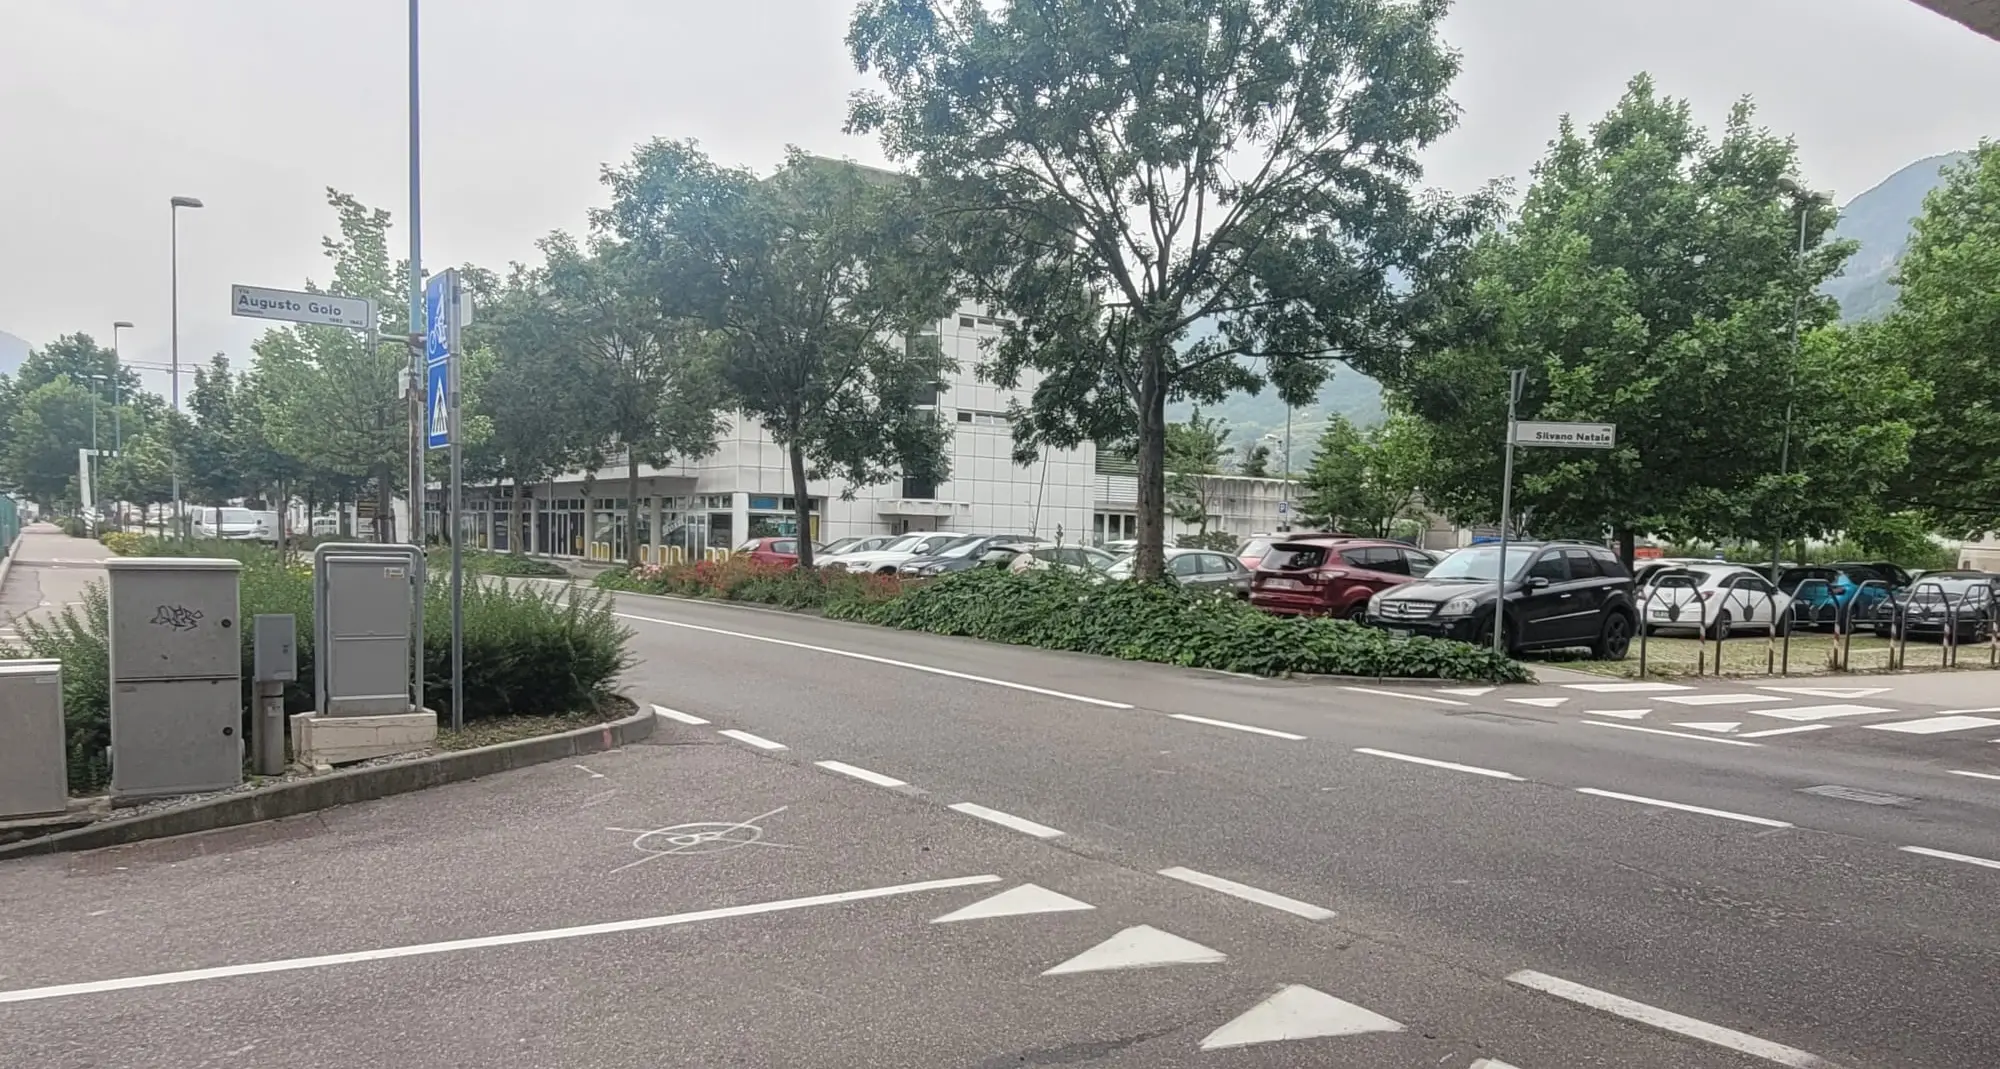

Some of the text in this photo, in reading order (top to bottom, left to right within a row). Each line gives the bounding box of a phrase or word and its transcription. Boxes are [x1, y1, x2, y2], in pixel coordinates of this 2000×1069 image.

[238, 294, 301, 312] Augusto
[1535, 431, 1610, 442] Silvano Natale
